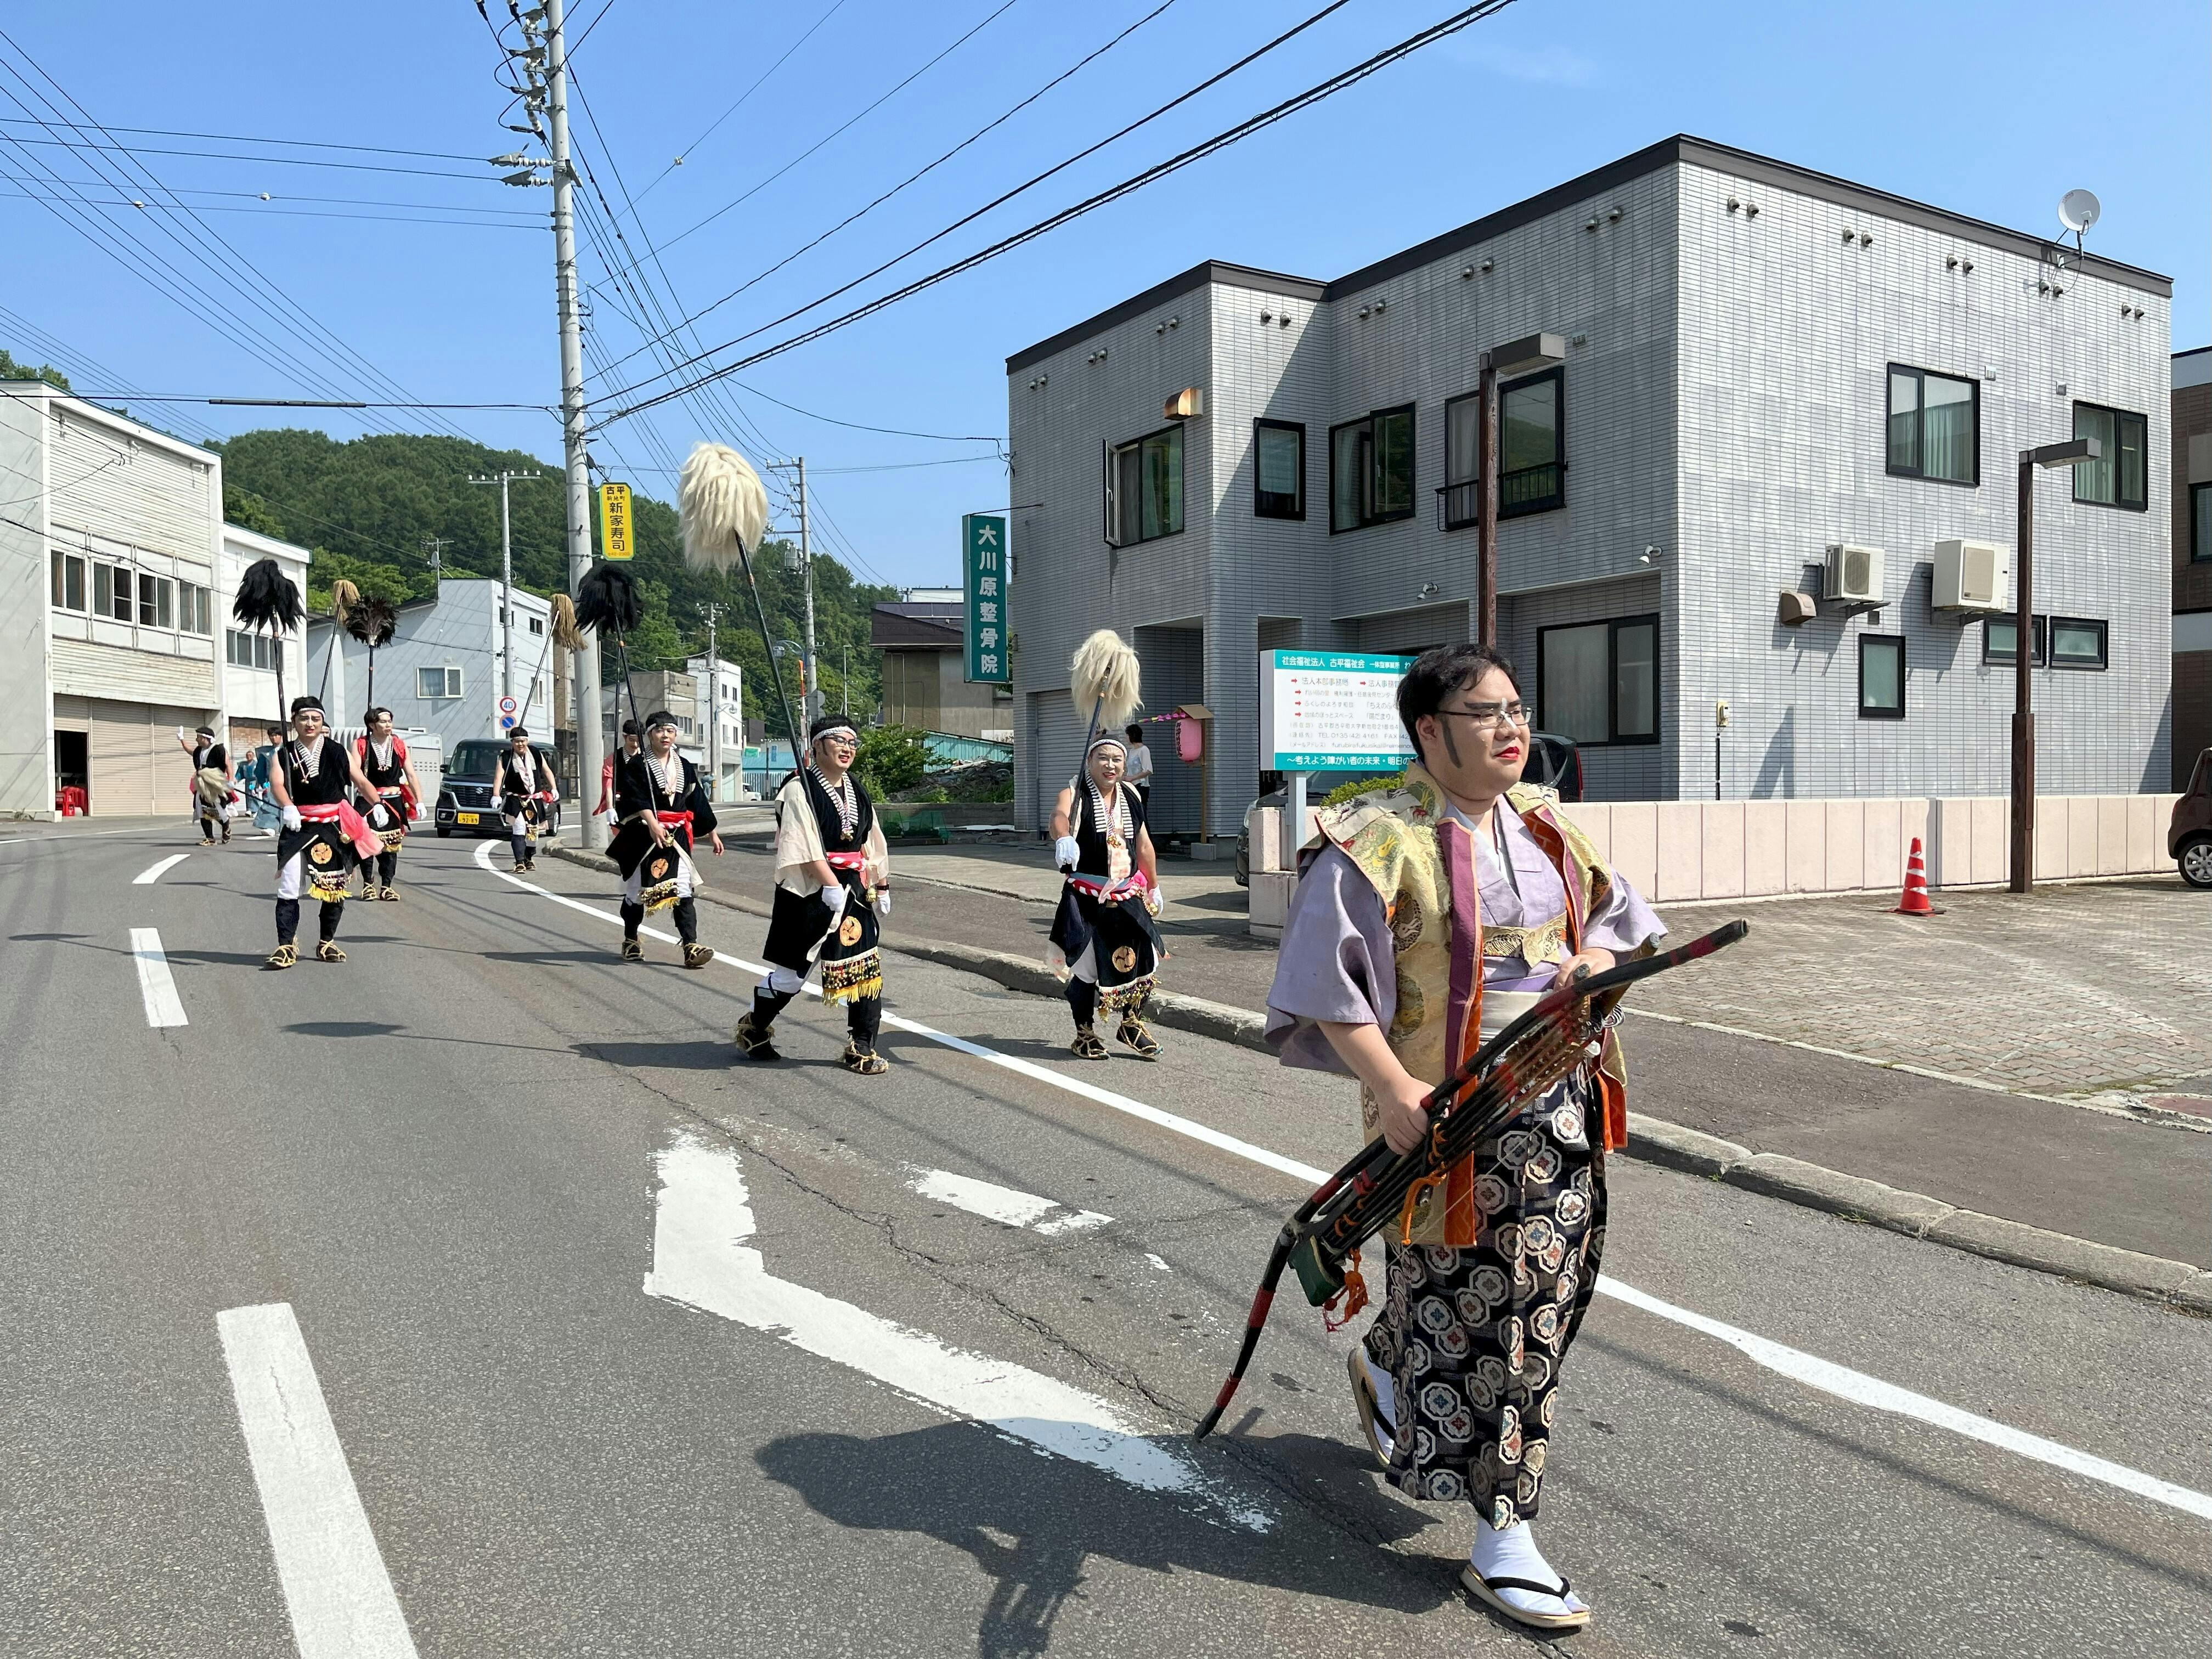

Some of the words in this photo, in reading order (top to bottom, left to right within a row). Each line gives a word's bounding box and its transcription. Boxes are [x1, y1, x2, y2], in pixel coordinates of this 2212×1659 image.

[606, 486, 625, 494] 古平
[609, 502, 624, 551] 新家寿司
[978, 524, 998, 674] 大川原整骨院
[1282, 656, 1325, 667] 社会福祉法人
[1330, 658, 1365, 669] 古平福祉会
